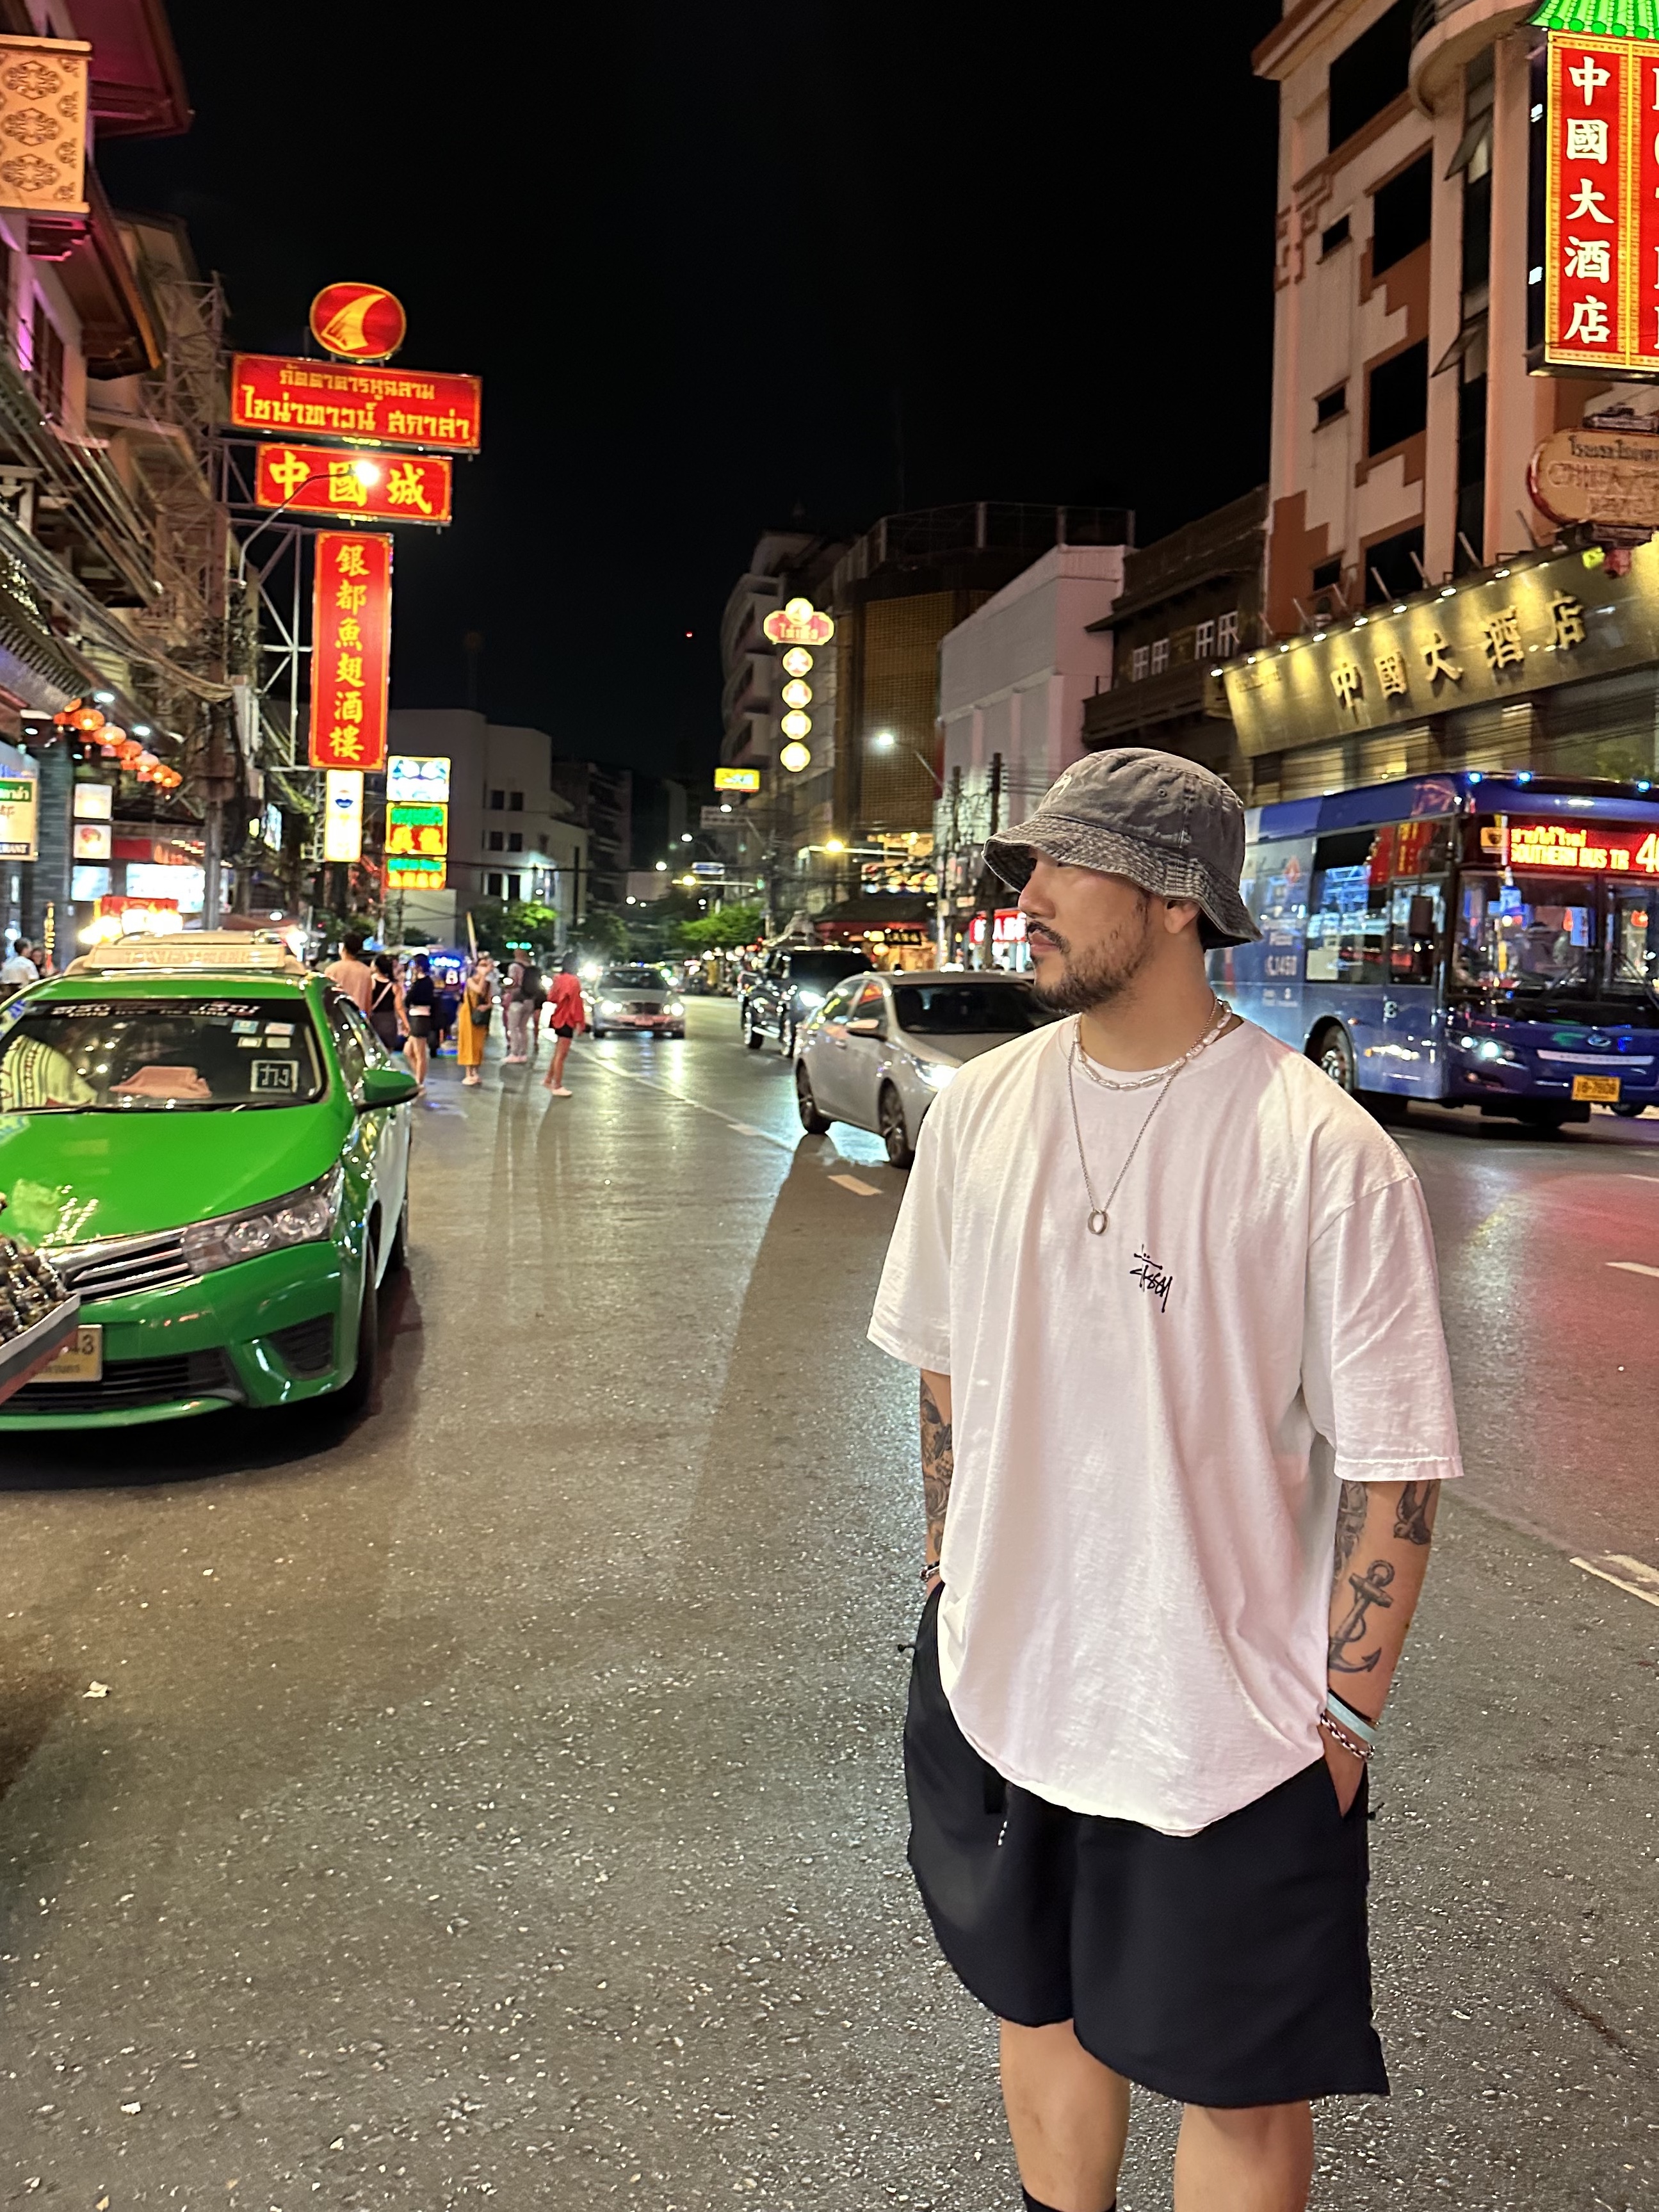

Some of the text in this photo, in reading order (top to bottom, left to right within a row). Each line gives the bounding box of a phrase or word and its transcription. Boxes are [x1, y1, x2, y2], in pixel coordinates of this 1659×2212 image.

[1564, 56, 1614, 344] 中國大酒店
[241, 384, 470, 440] ไชน่าทาวน์ สกาล่า
[268, 450, 433, 514] 中國城
[1331, 590, 1587, 708] 中國大酒店
[1510, 833, 1659, 873] SOUTHERN BUS TR 4
